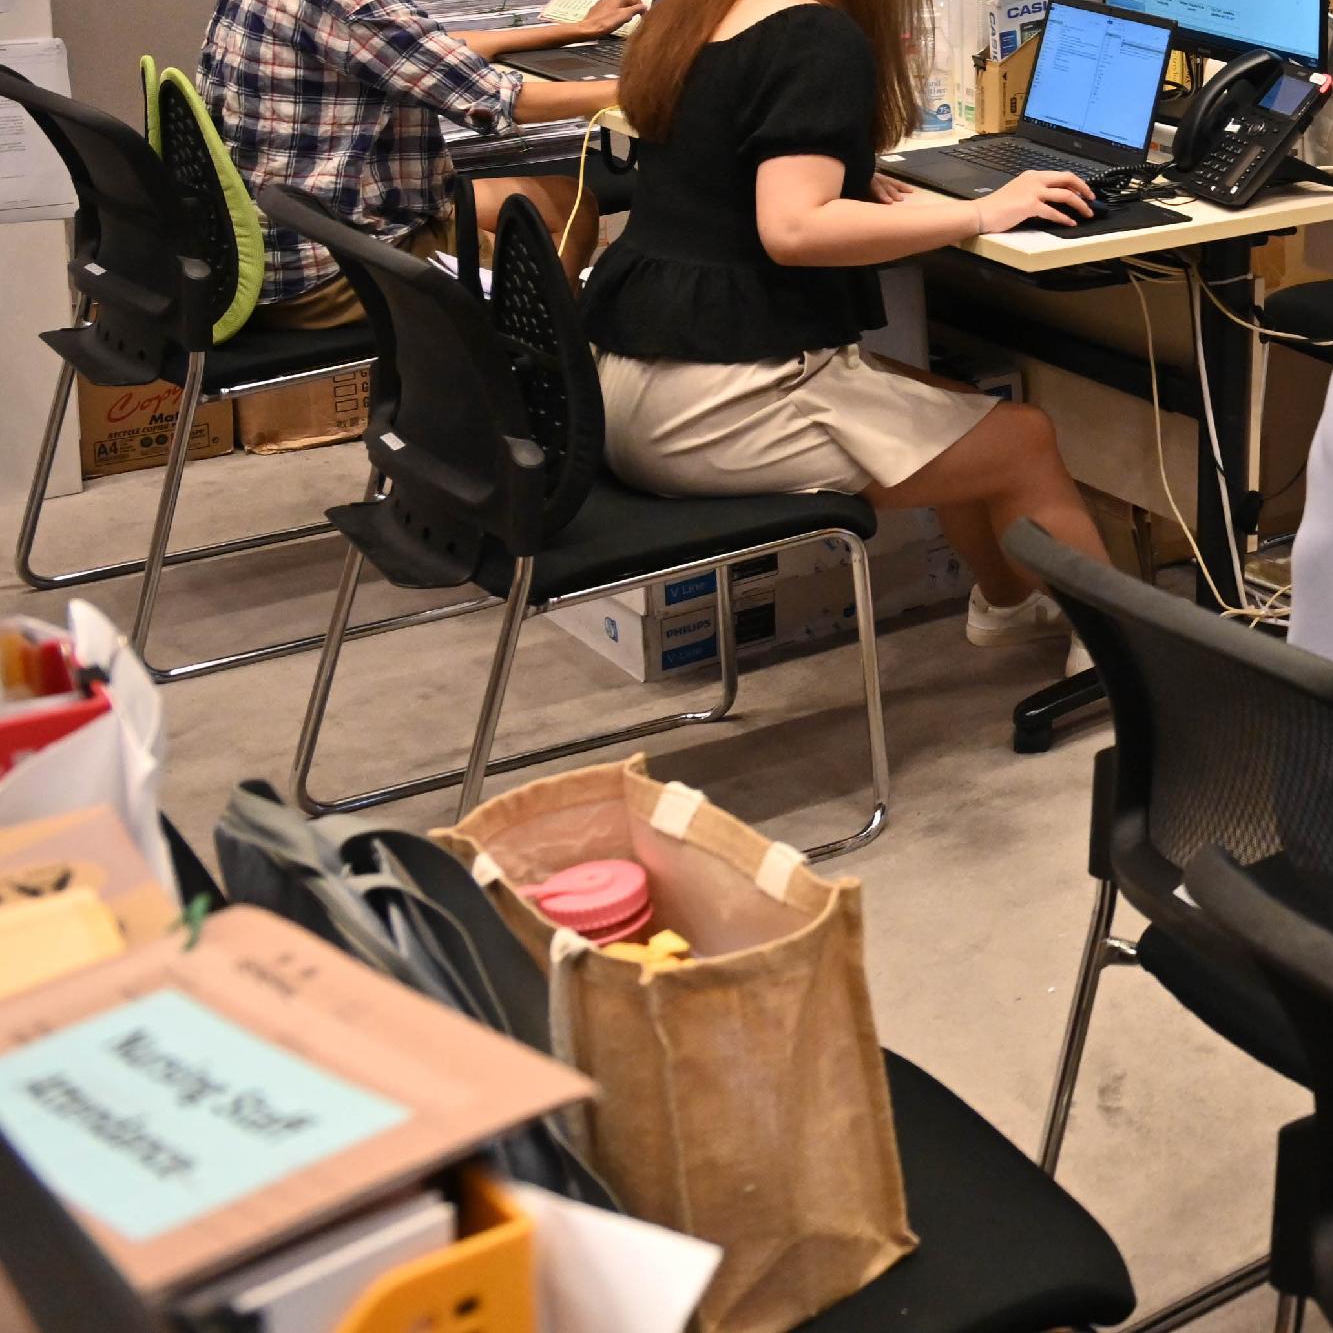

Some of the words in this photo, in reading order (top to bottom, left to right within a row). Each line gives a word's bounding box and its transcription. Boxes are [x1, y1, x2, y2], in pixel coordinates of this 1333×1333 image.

[1007, 1, 1049, 19] CASI
[149, 412, 180, 425] Mat
[98, 441, 118, 458] A4
[666, 619, 713, 639] PHILIPS
